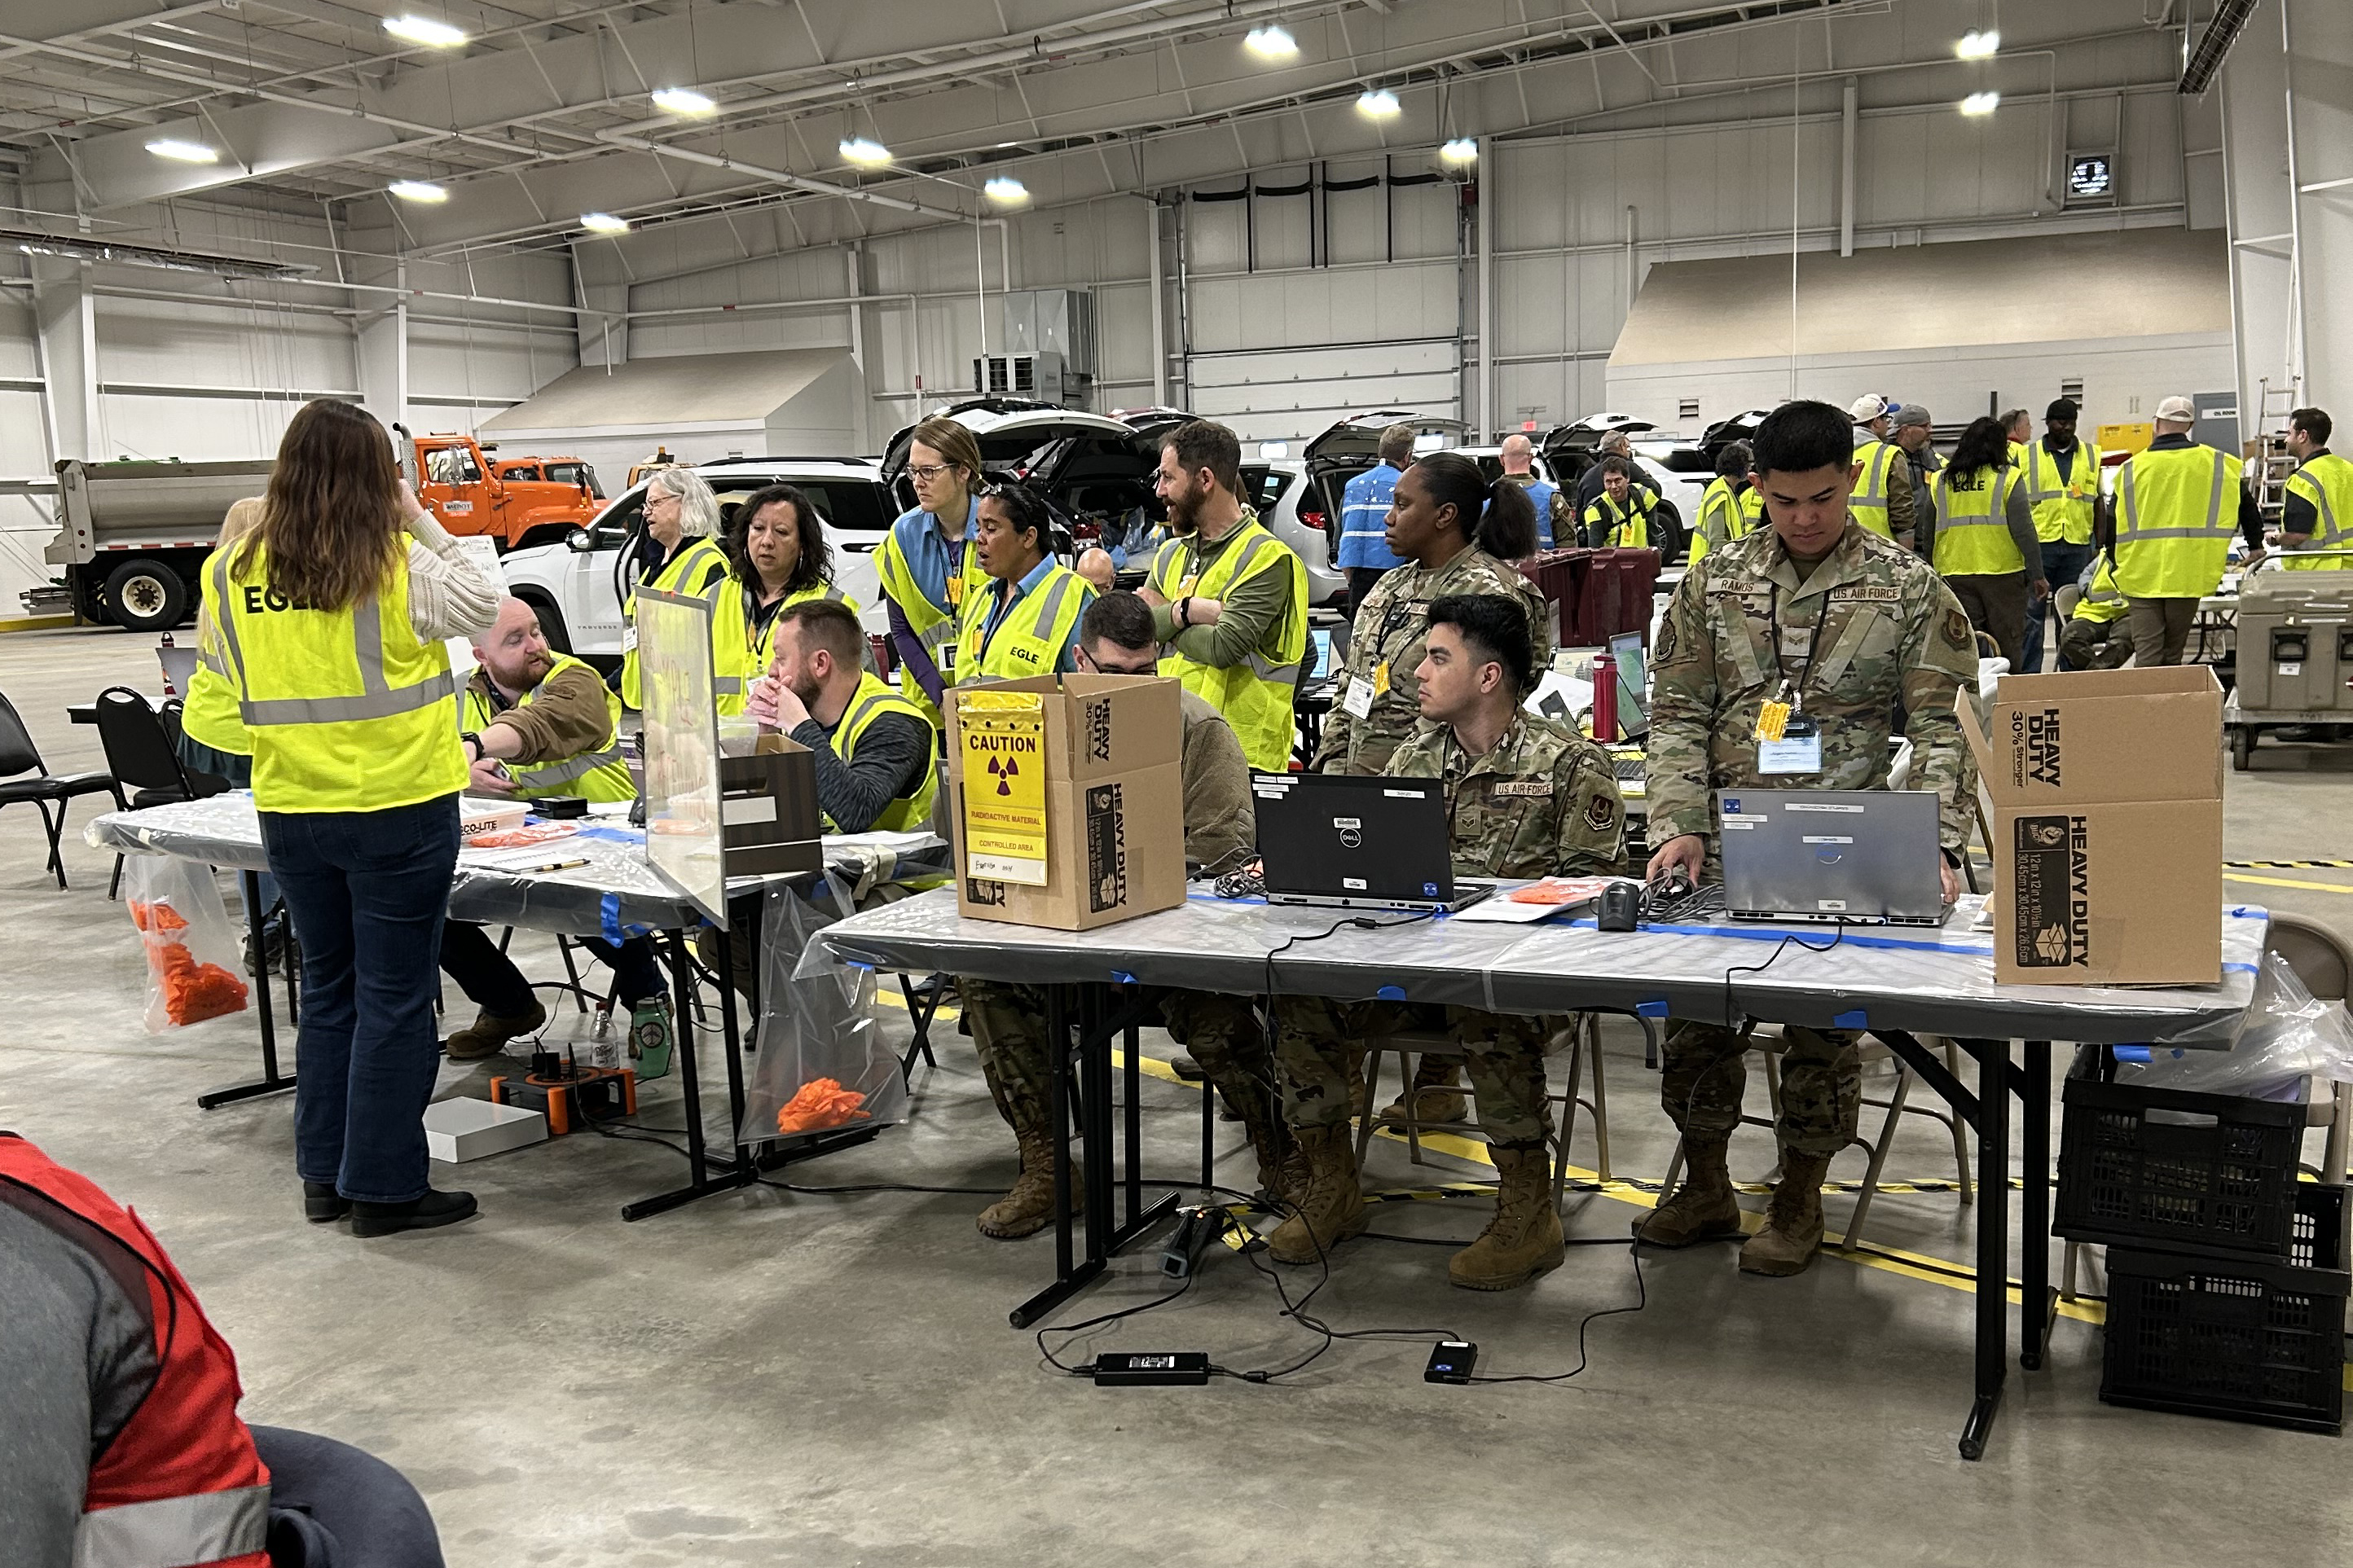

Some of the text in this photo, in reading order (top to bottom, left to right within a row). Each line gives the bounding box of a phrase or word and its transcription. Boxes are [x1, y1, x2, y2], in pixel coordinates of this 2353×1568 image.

[1954, 481, 1985, 493] EGLE
[1721, 579, 1754, 592] RAMOS
[1850, 588, 1866, 599] AIR
[1868, 588, 1898, 599] FORCE
[1010, 647, 1039, 664] EGLE
[1093, 705, 1102, 758] DUTY
[1102, 698, 1111, 762] HEAVY
[970, 735, 1036, 753] CAUTION
[2012, 710, 2024, 788] 30% Stronger
[2028, 715, 2044, 782] DUTY
[2044, 709, 2061, 788] HEAVY
[1511, 784, 1525, 793] AIR
[1527, 784, 1550, 794] FORCE
[971, 810, 1041, 825] RADIOACTIVE MATERIAL
[979, 840, 1017, 850] CONTROLLED
[1114, 783, 1126, 906] HEAVY DUTY
[2071, 816, 2088, 968] HEAVY DUTY
